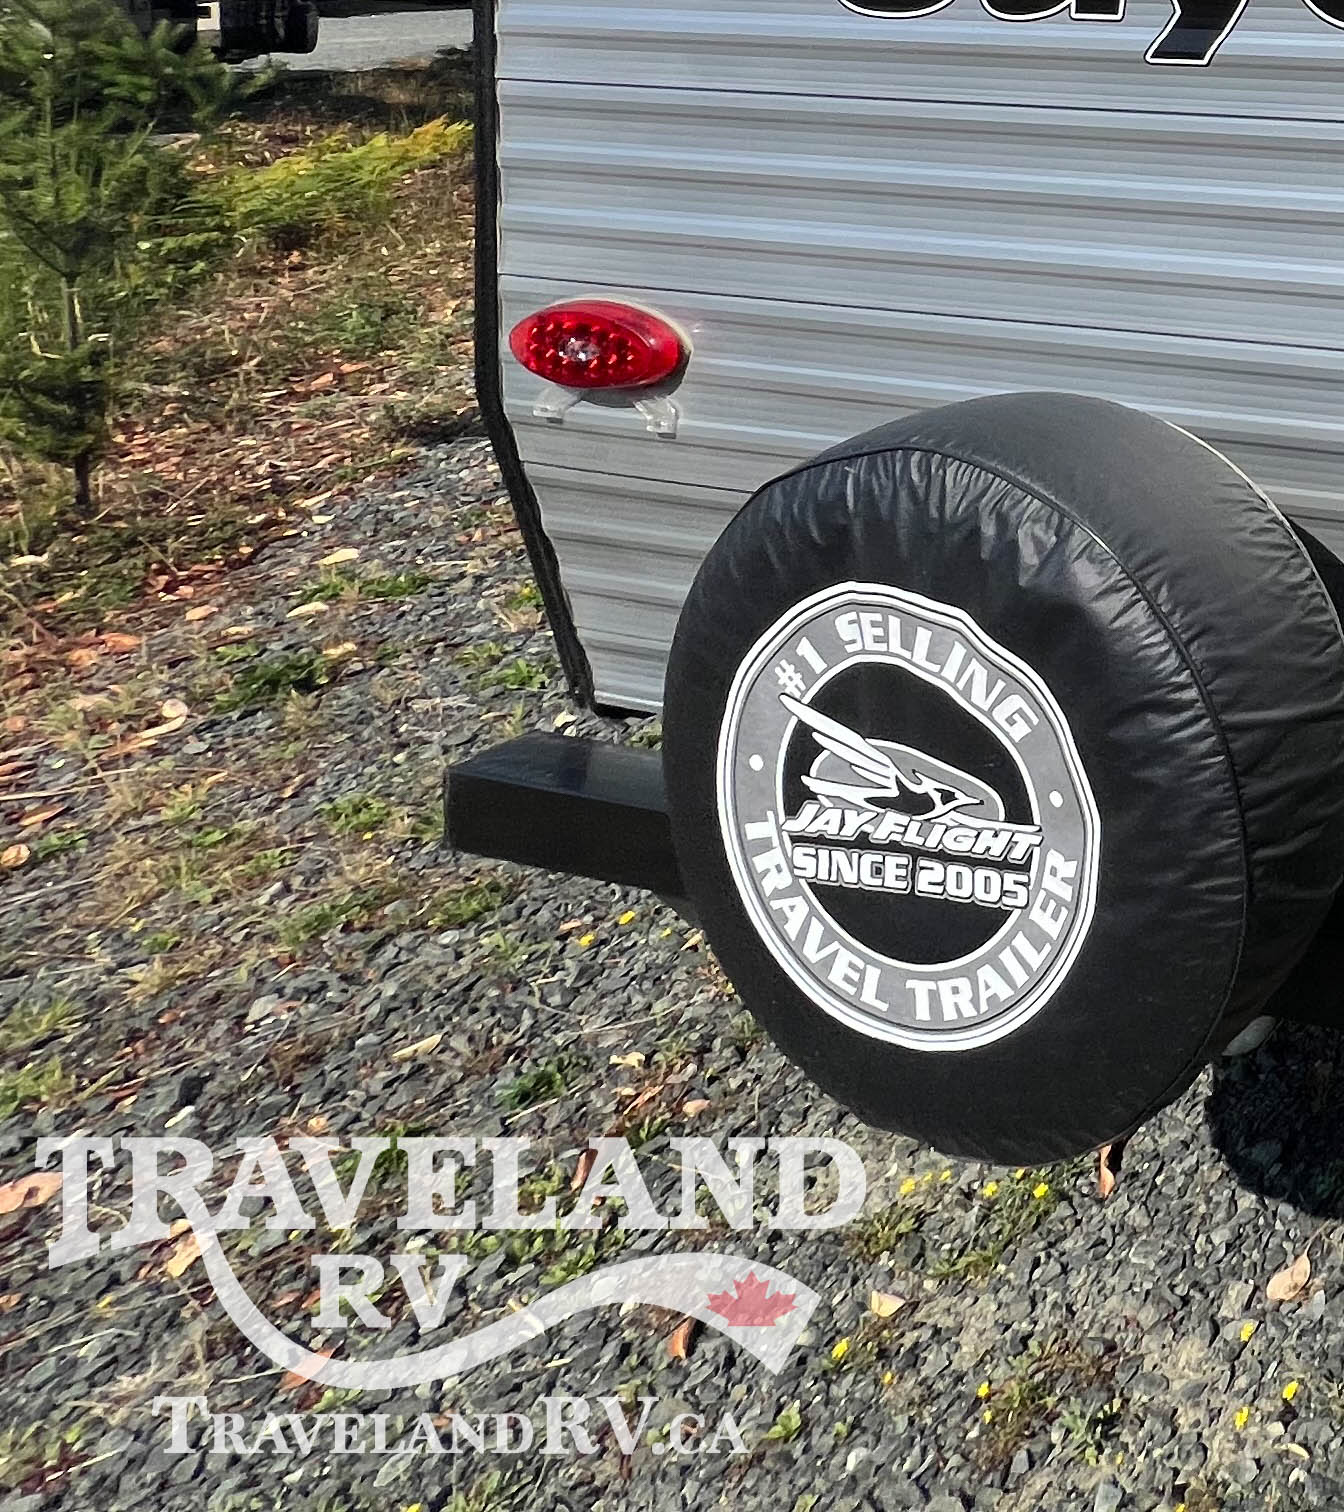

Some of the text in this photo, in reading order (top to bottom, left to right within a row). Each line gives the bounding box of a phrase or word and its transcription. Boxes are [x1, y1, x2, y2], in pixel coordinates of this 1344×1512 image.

[773, 610, 1039, 743] #1 SELLING
[743, 809, 1078, 1022] TRAVEL TRAILER
[793, 845, 1031, 909] SINCE 2005
